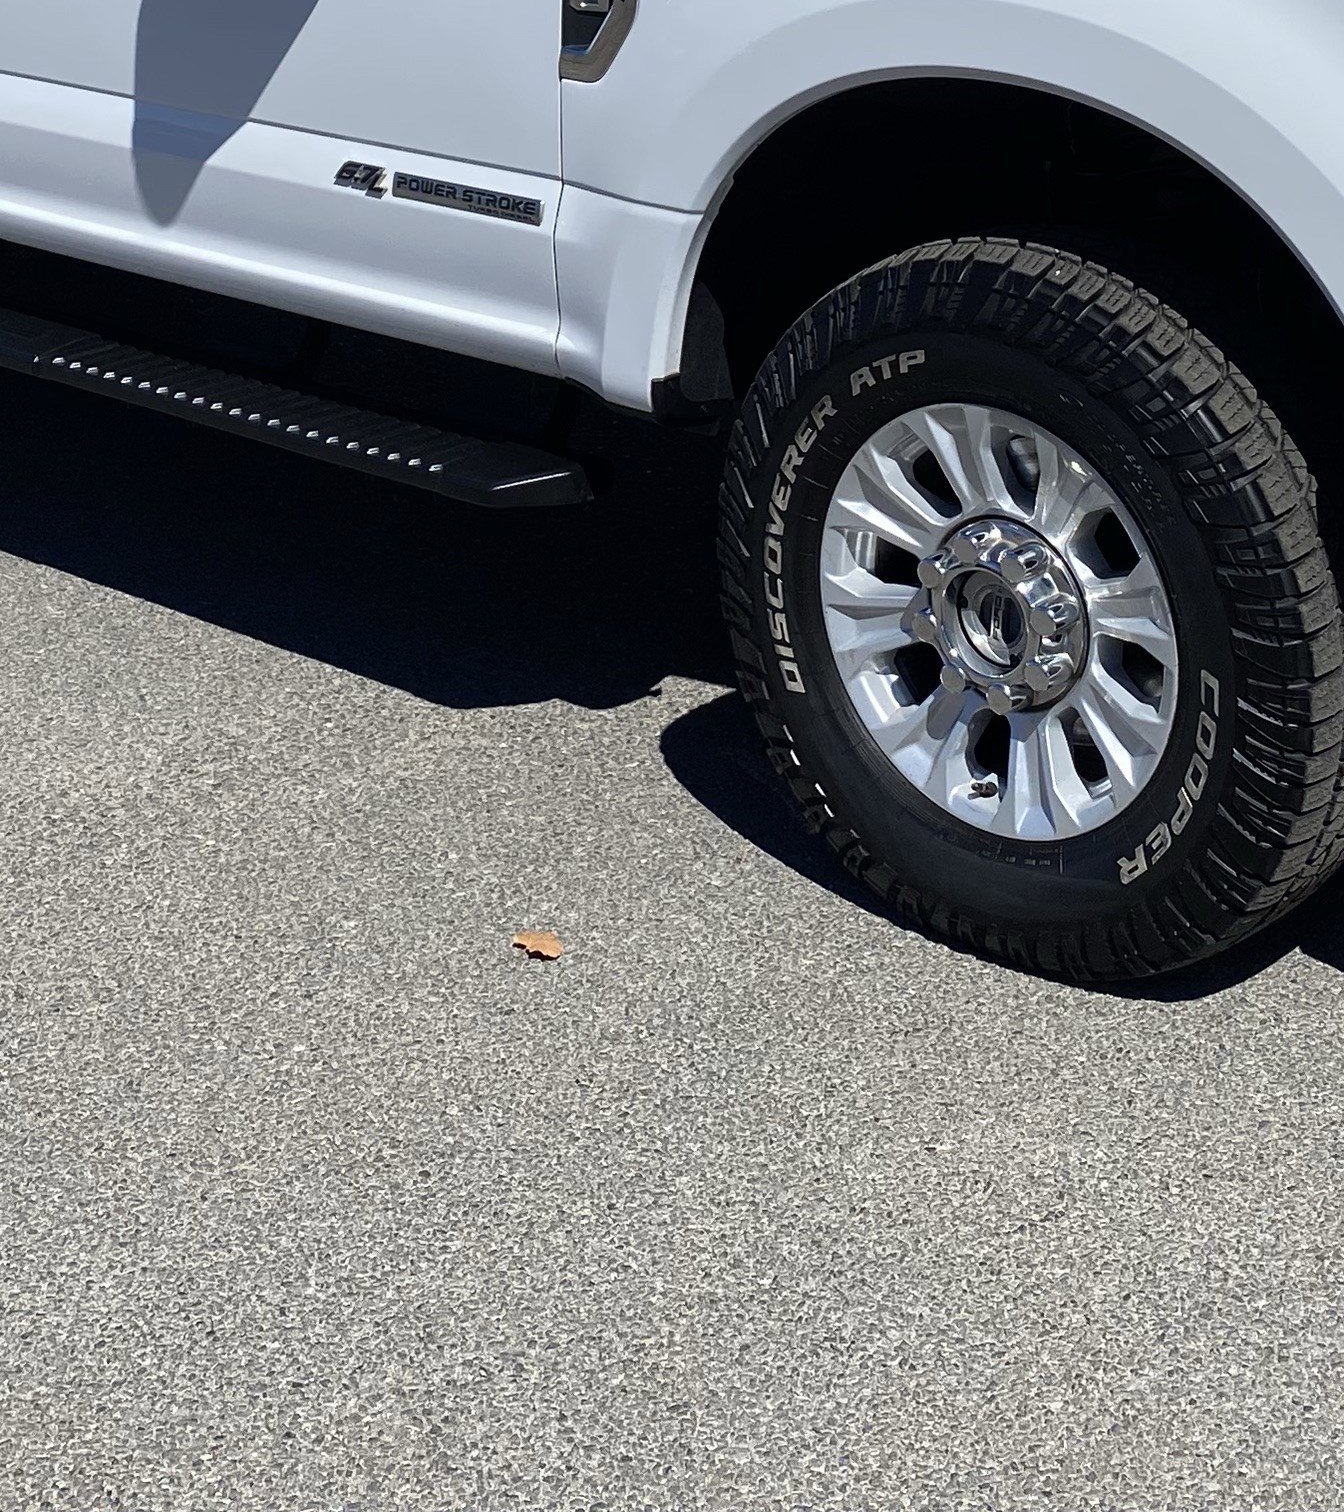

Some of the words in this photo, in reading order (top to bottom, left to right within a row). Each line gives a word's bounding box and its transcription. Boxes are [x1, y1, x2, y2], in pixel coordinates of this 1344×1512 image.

[396, 175, 457, 200] POWER
[461, 189, 537, 216] STROKE
[763, 394, 838, 694] DISCOVERER
[850, 349, 926, 396] ATP
[1117, 669, 1220, 885] COOPER
